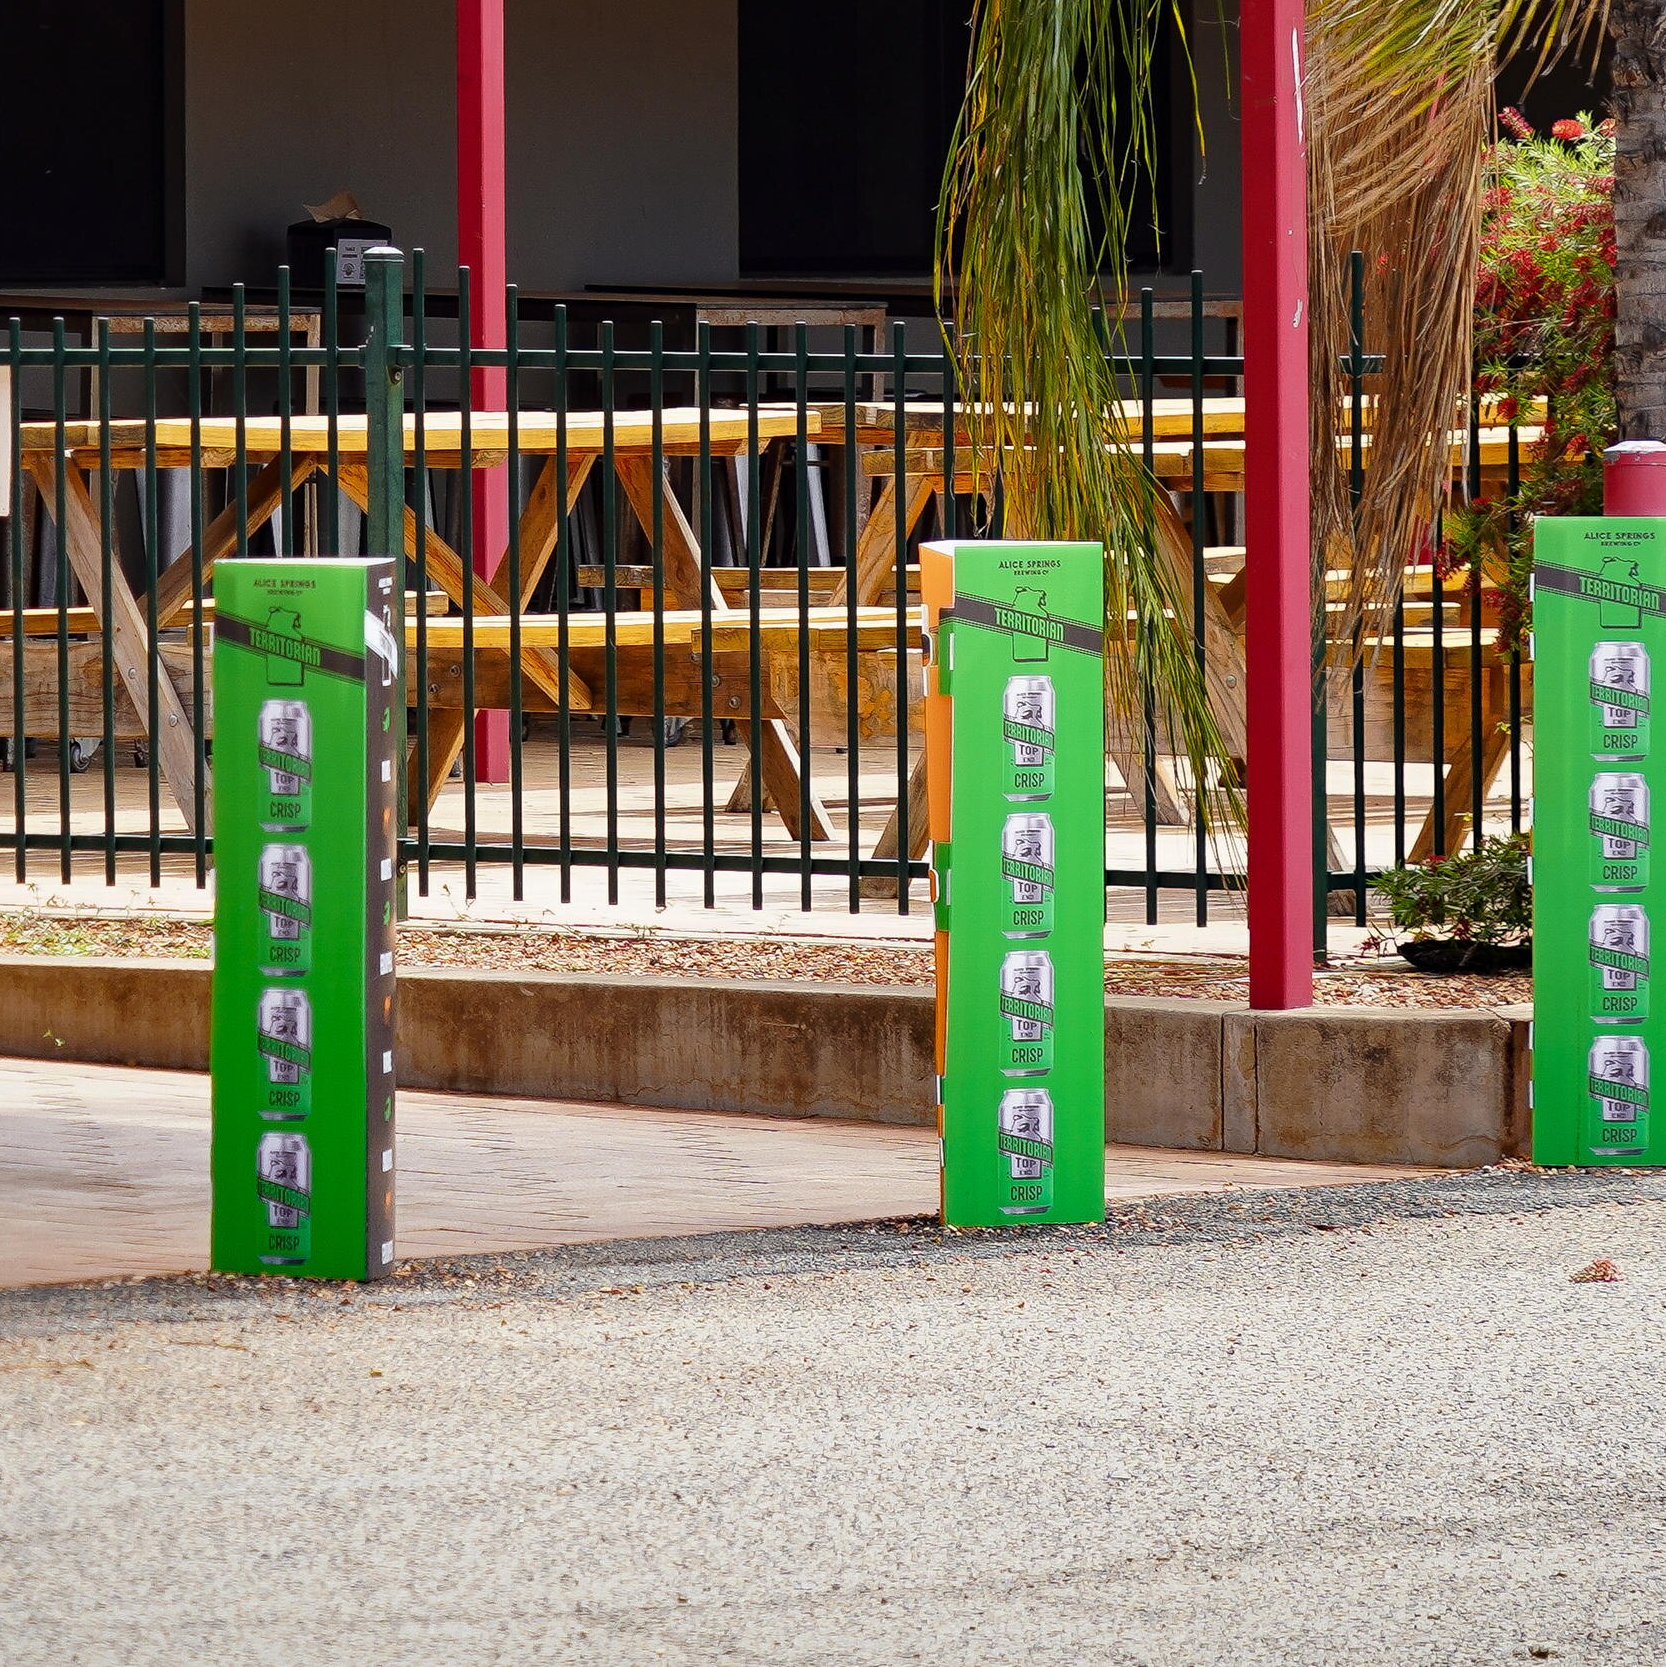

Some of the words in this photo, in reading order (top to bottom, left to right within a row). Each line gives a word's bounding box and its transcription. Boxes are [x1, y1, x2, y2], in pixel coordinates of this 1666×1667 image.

[1583, 532, 1612, 540] ALICE
[1615, 532, 1656, 540] SPRINGS
[998, 560, 1024, 569] ALICE
[1027, 559, 1062, 569] SPRINGS
[1578, 575, 1661, 611] TERRITORIAN
[993, 607, 1065, 642] TERRITORIAN
[249, 627, 321, 667] TERRITORIAN
[1607, 707, 1631, 718] TOP
[1603, 734, 1638, 749] CRISP
[1019, 744, 1039, 755] TOP
[1014, 773, 1045, 788] CRISP
[270, 802, 301, 818] CRISP
[1607, 838, 1631, 849] TOP
[1603, 865, 1638, 880] CRISP
[1018, 881, 1038, 893] TOP
[1013, 910, 1044, 925] CRISP
[269, 946, 301, 962] CRISP
[1607, 969, 1631, 980] TOP
[1603, 997, 1638, 1011] CRISP
[1016, 1019, 1037, 1030] TOP
[1011, 1048, 1043, 1063] CRISP
[269, 1090, 300, 1106] CRISP
[1607, 1101, 1631, 1112] TOP
[1602, 1128, 1637, 1143] CRISP
[1015, 1157, 1036, 1168] TOP
[1010, 1185, 1043, 1201] CRISP
[268, 1235, 300, 1250] CRISP
